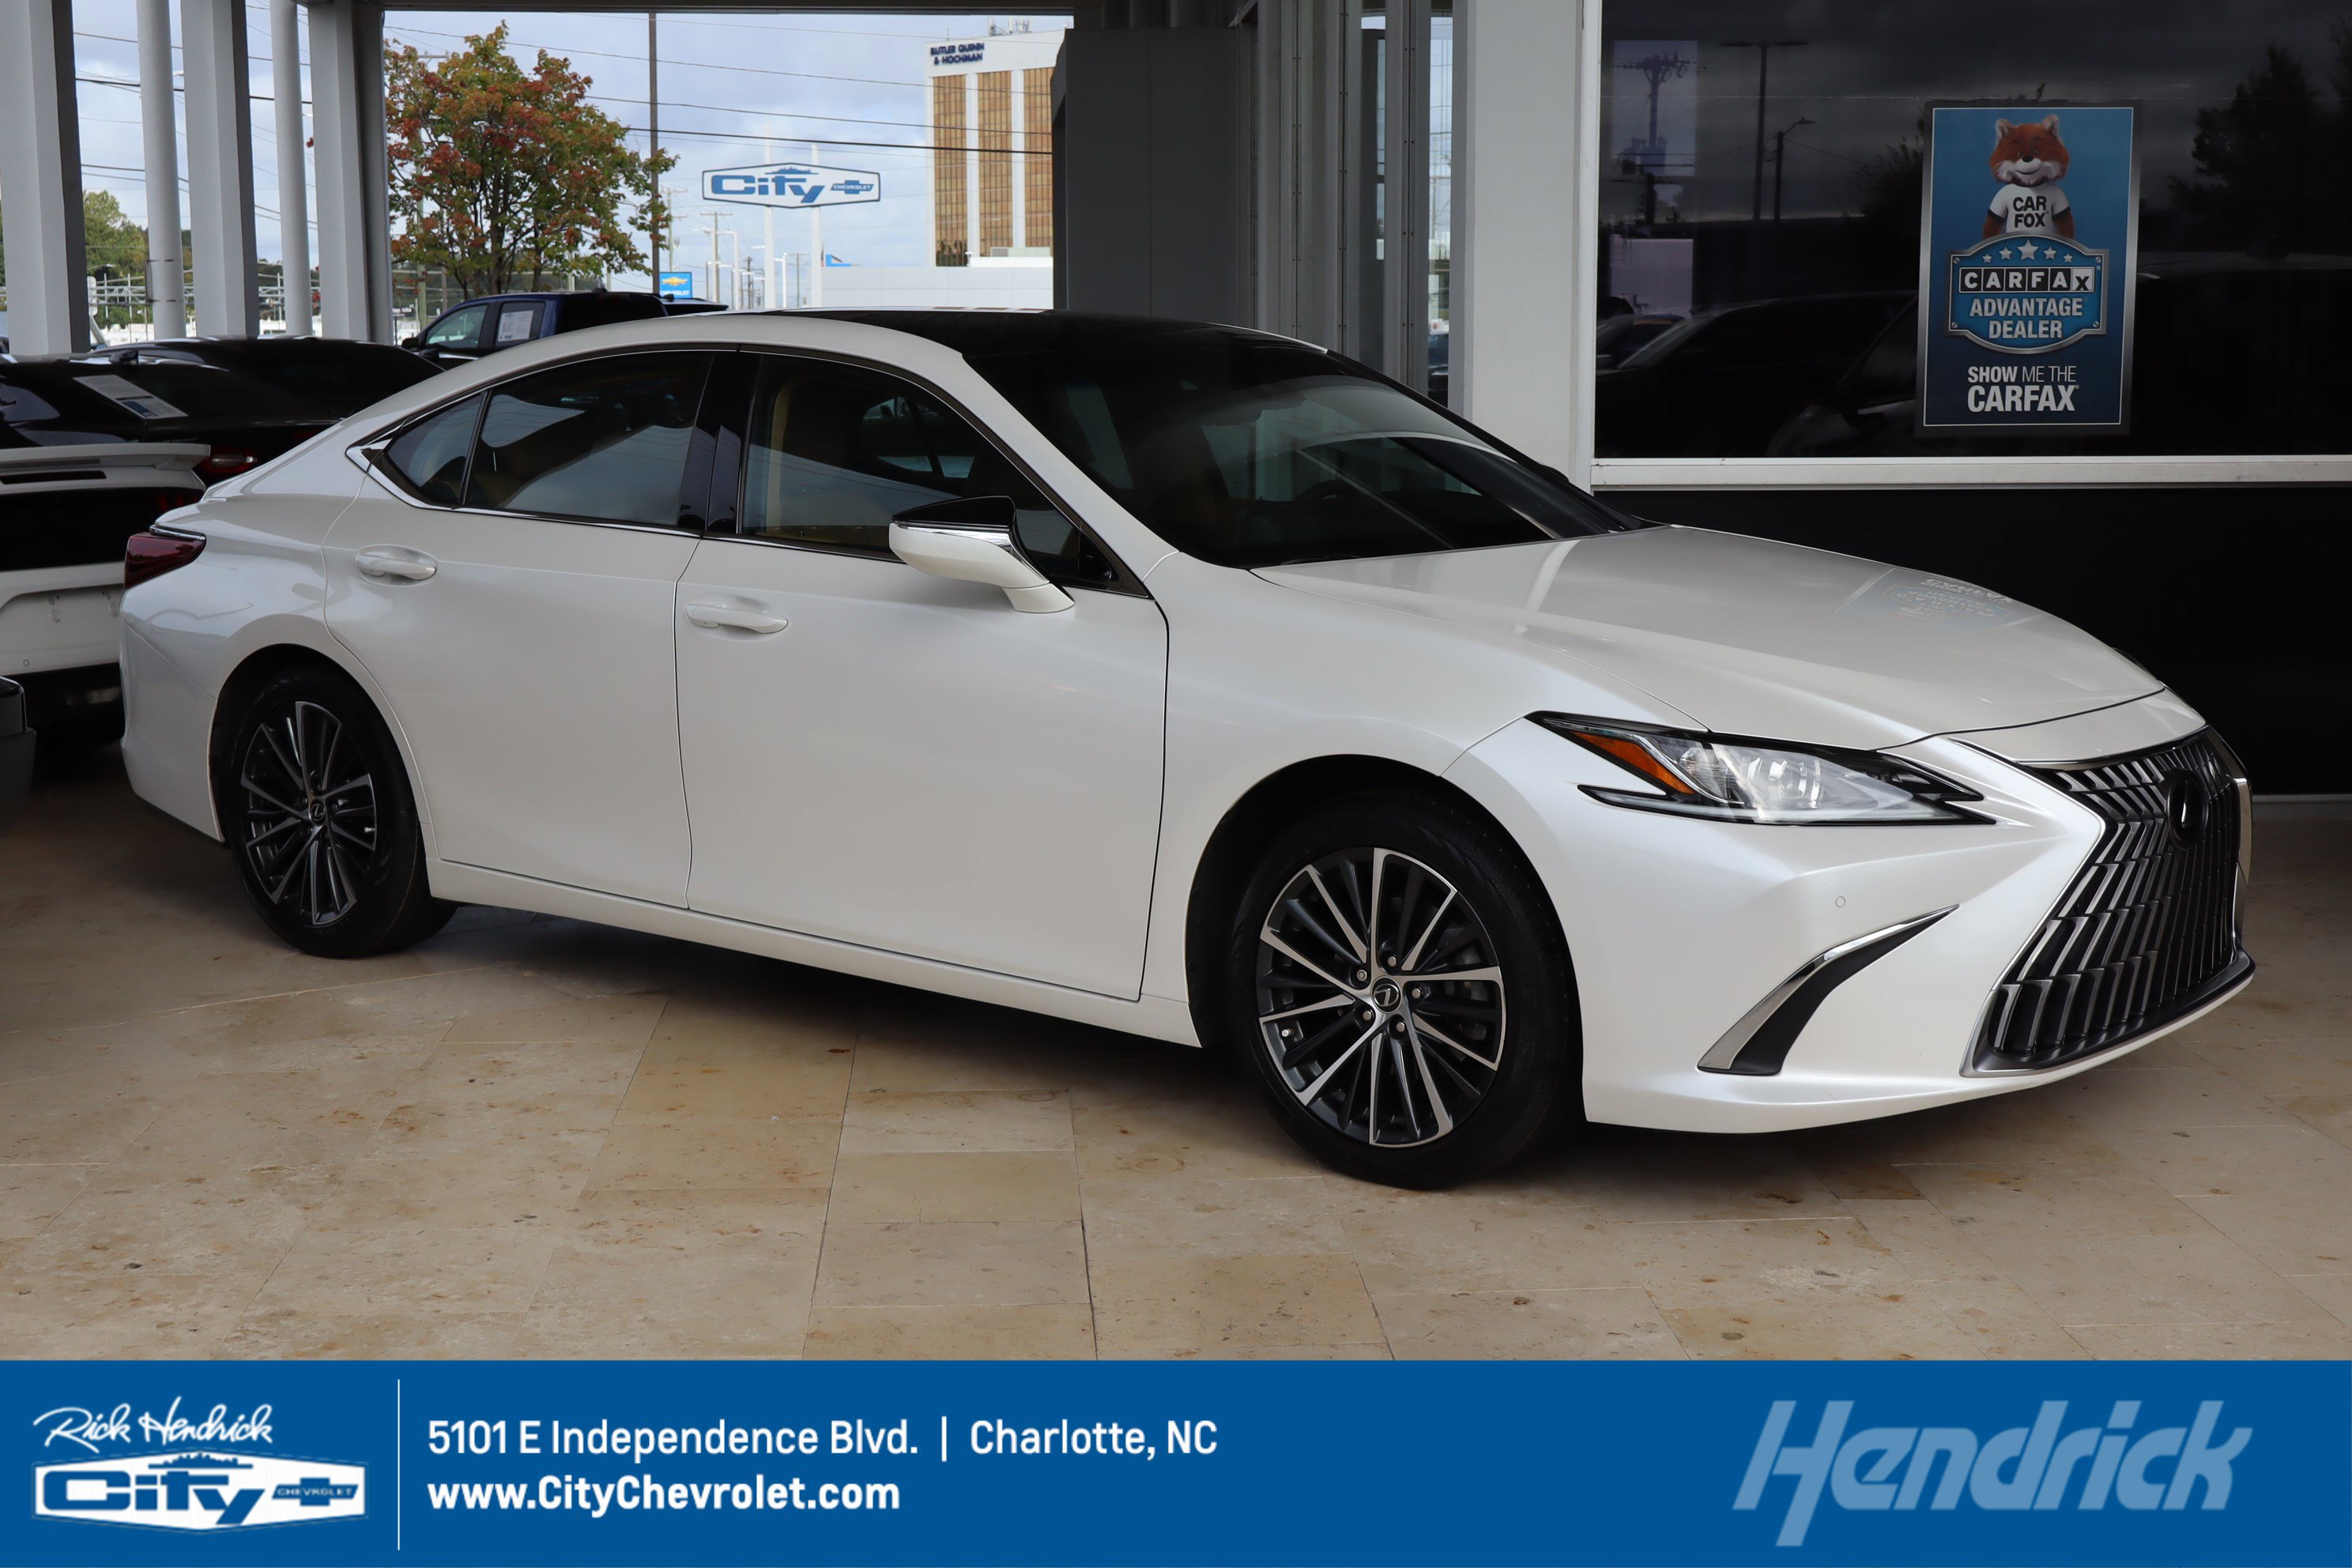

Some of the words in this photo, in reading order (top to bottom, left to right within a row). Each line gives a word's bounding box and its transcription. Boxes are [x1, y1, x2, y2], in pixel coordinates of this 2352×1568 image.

[958, 42, 985, 53] QUINN
[711, 175, 825, 202] City
[2013, 196, 2047, 212] CAR
[2015, 213, 2046, 228] FOX
[1963, 271, 2093, 292] CARFAX
[1969, 298, 2082, 316] ADVANTAGE
[1988, 320, 2063, 339] DEALER
[1968, 366, 2018, 383] SHOW
[2022, 366, 2045, 383] ME
[2049, 366, 2077, 383] THE
[1967, 385, 2076, 412] CARFAX
